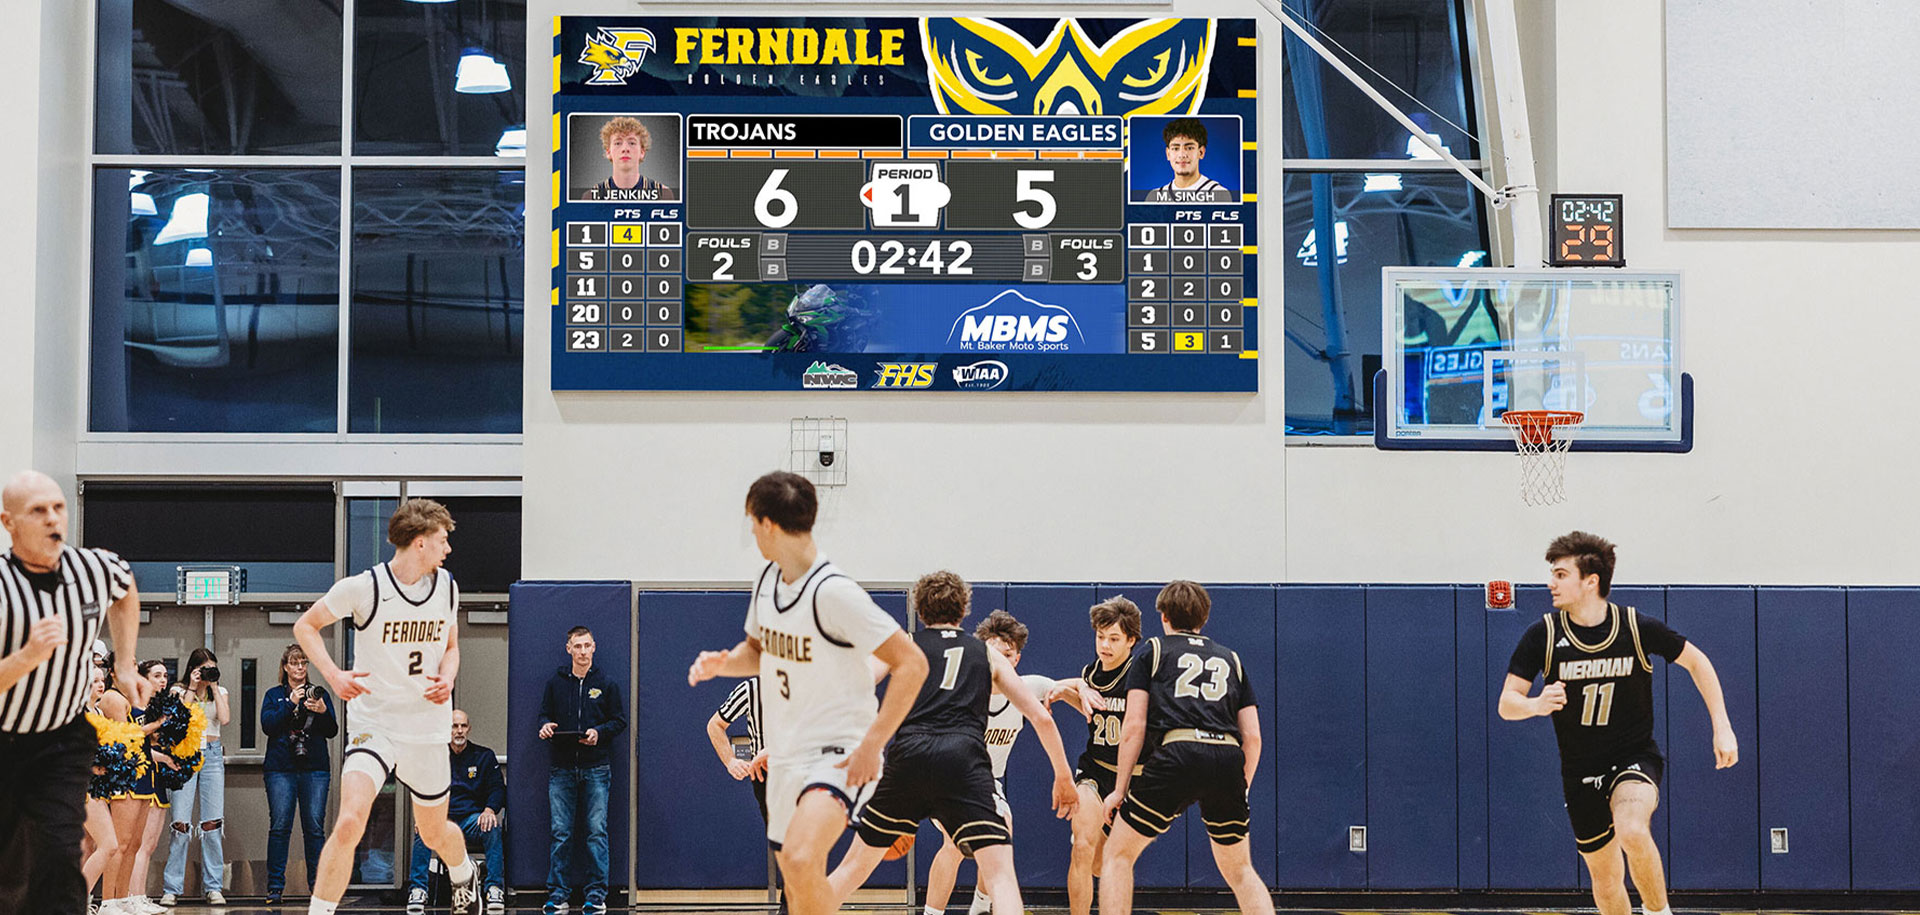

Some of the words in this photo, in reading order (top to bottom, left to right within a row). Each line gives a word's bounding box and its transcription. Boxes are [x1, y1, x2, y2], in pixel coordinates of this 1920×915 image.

[674, 27, 905, 66] FERNDALE
[687, 73, 774, 85] GOLDEN
[799, 74, 884, 86] EAGLES
[693, 122, 797, 141] TROJANS
[929, 123, 1024, 141] GOLDEN
[1032, 123, 1117, 142] EAGLES
[878, 169, 933, 180] PERIOD
[591, 190, 601, 200] T.
[603, 190, 659, 200] JENKINS
[754, 169, 799, 229] 6
[890, 183, 920, 222] 1
[1012, 169, 1057, 230] 5
[1156, 191, 1172, 202] M.
[1174, 191, 1215, 202] SINGH
[614, 208, 641, 219] PTS
[650, 208, 679, 219] FLS
[1175, 210, 1202, 221] PTS
[1211, 210, 1240, 221] FLS
[1562, 201, 1614, 222] 02:42
[581, 225, 592, 243] 1
[622, 228, 633, 241] 4
[659, 228, 670, 242] 0
[697, 237, 751, 249] FOULS
[1142, 227, 1155, 244] 0
[1184, 230, 1194, 243] 0
[1221, 230, 1231, 243] 1
[1561, 224, 1614, 261] 29
[767, 239, 779, 250] B
[1031, 240, 1044, 251] B
[1060, 238, 1114, 250] FOULS
[579, 252, 594, 270] 5
[622, 254, 633, 268] 0
[659, 254, 670, 268] 0
[712, 252, 734, 280] 2
[851, 239, 973, 275] 02:42
[1143, 254, 1154, 272] 1
[1184, 256, 1194, 270] 0
[1221, 256, 1231, 270] 0
[767, 263, 779, 275] B
[1031, 264, 1044, 276] B
[1076, 252, 1098, 281] 3
[576, 278, 596, 296] 11
[622, 281, 633, 295] 0
[659, 281, 670, 295] 0
[1142, 280, 1155, 298] 2
[1184, 282, 1194, 296] 2
[1221, 282, 1232, 296] 0
[572, 305, 600, 323] 20
[622, 307, 633, 321] 0
[659, 307, 670, 321] 0
[1142, 306, 1156, 324] 3
[1184, 309, 1194, 322] 0
[1221, 309, 1232, 322] 0
[960, 315, 1069, 342] MBMS
[572, 331, 600, 349] 23
[622, 334, 633, 347] 2
[659, 334, 670, 347] 0
[960, 341, 974, 350] Mt.
[978, 341, 1006, 350] Baker
[1009, 341, 1035, 350] Moto
[1037, 341, 1069, 352] Sports
[1142, 333, 1156, 351] 5
[1184, 335, 1195, 348] 3
[1221, 335, 1231, 349] 1
[803, 374, 858, 387] NWC
[876, 363, 936, 387] FHS
[961, 368, 1000, 380] WIAA
[194, 576, 222, 599] EXIT
[408, 650, 423, 676] 2
[939, 646, 965, 690] 1
[1558, 656, 1635, 681] MERIDIAN
[776, 668, 791, 700] 3
[1174, 652, 1231, 702] 23
[1581, 682, 1616, 727] 11
[1093, 713, 1122, 746] 20
